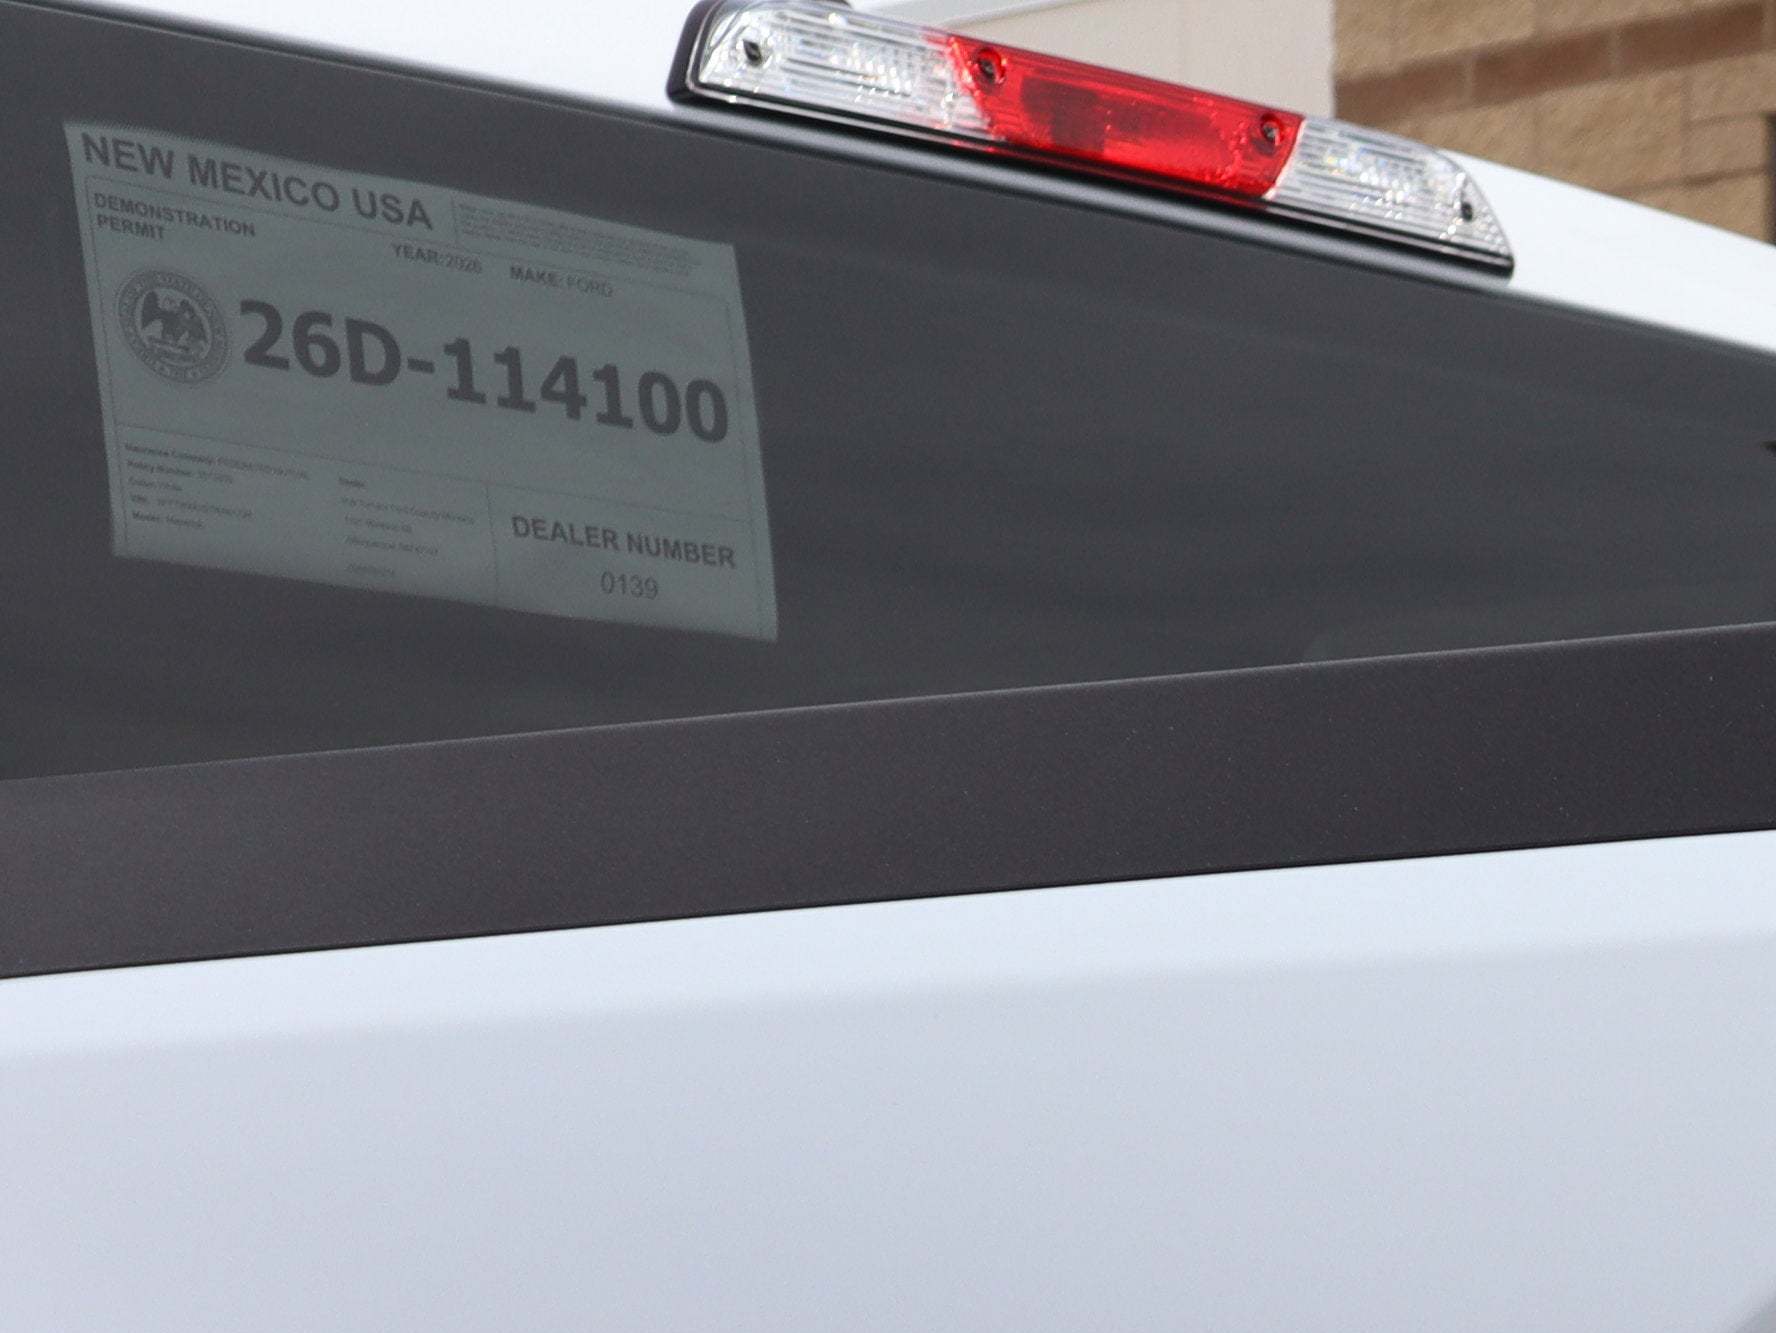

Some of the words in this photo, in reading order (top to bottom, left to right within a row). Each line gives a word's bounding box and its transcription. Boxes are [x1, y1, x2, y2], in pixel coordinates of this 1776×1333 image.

[81, 132, 175, 180] NEW
[187, 153, 341, 212] MEXICO
[352, 187, 434, 232] USA
[94, 192, 256, 238] DEMONSTRATION
[96, 214, 165, 240] PERMIT
[239, 299, 729, 444] 26D-114100
[511, 515, 619, 551] DEALER
[627, 531, 737, 569] NUMBER
[600, 570, 659, 600] 0139
